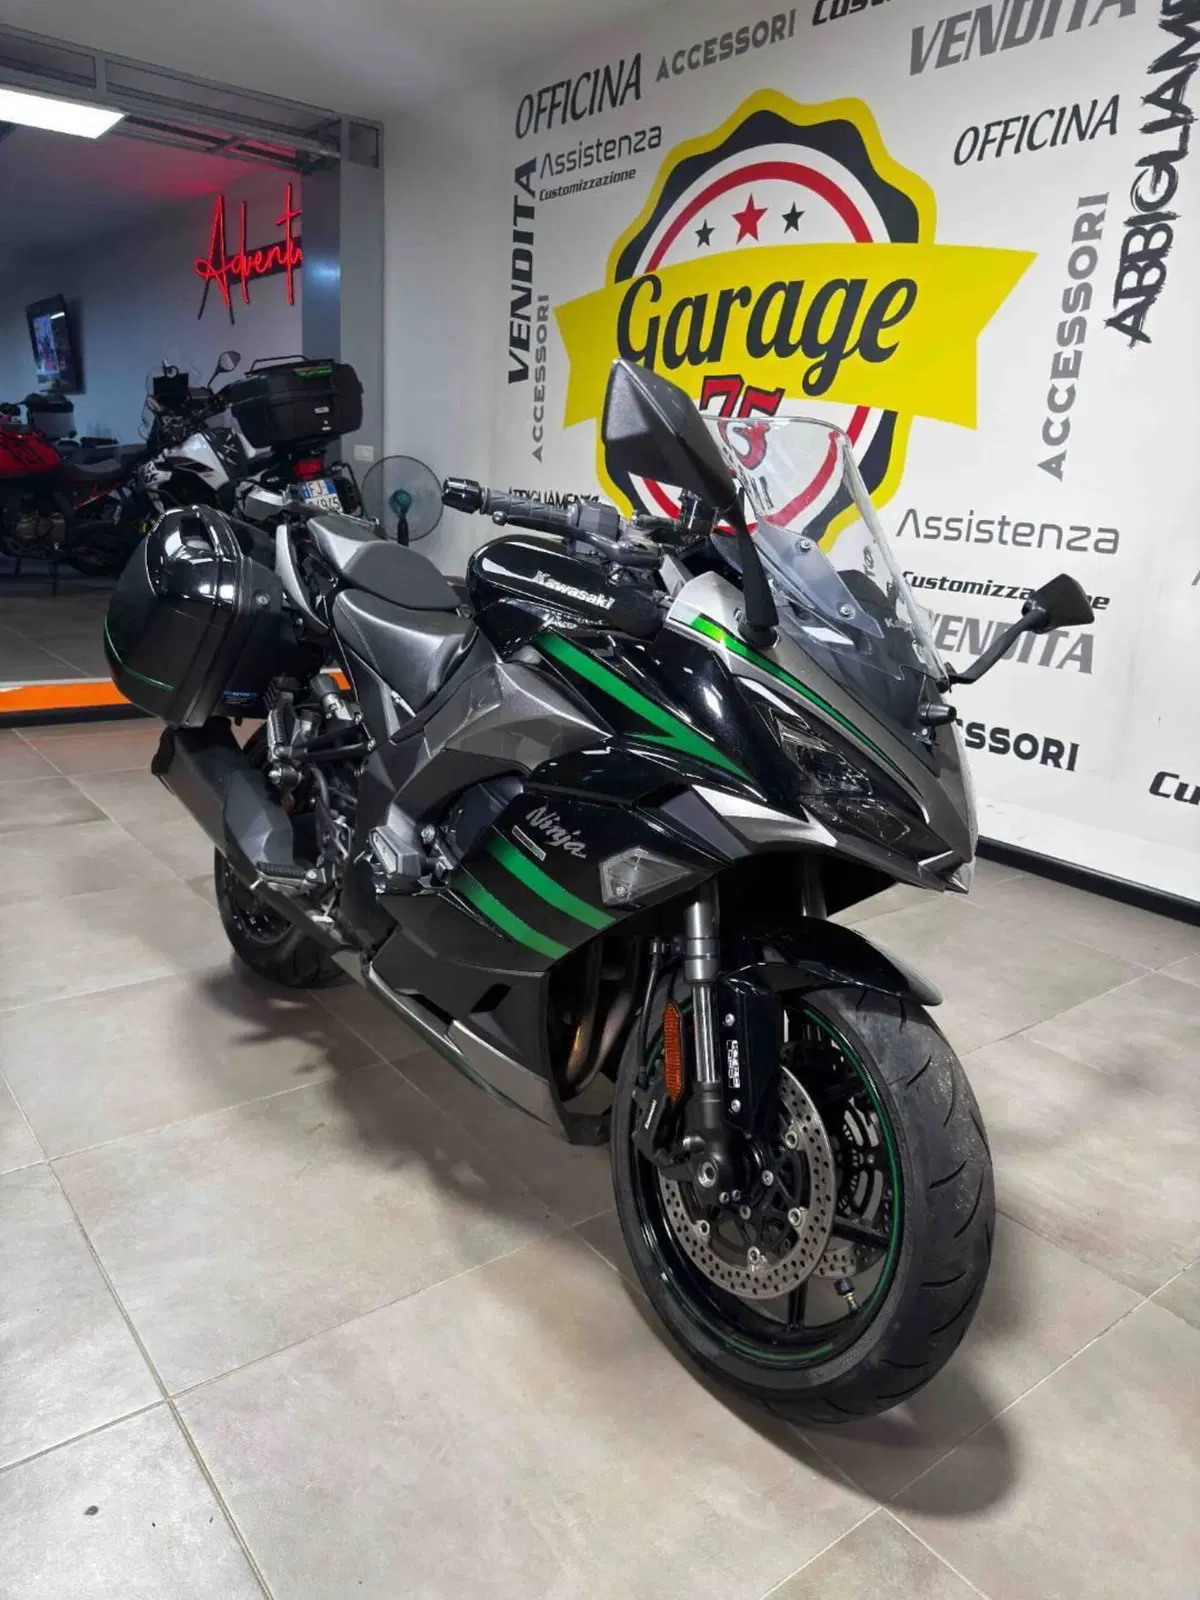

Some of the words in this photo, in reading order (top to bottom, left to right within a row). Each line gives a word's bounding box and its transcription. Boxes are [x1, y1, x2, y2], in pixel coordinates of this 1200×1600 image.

[655, 9, 796, 83] ACCESSORI
[515, 53, 642, 139] OFFICINA
[953, 94, 1120, 165] OFFICINA
[539, 168, 637, 202] Customizzazione
[540, 125, 662, 179] Assistenza
[1102, 0, 1200, 349] ABBIGLIAM
[508, 157, 537, 384] VENDITA
[616, 273, 918, 397] Garage
[1037, 191, 1109, 481] ACCESSORI
[532, 295, 549, 463] ACCESSORI
[699, 374, 786, 471] 75
[896, 508, 1120, 554] Assistenza
[533, 569, 616, 610] Kawasaki
[902, 571, 1110, 610] Customizzae
[955, 718, 1080, 772] SSORI
[525, 805, 587, 859] Ninja
